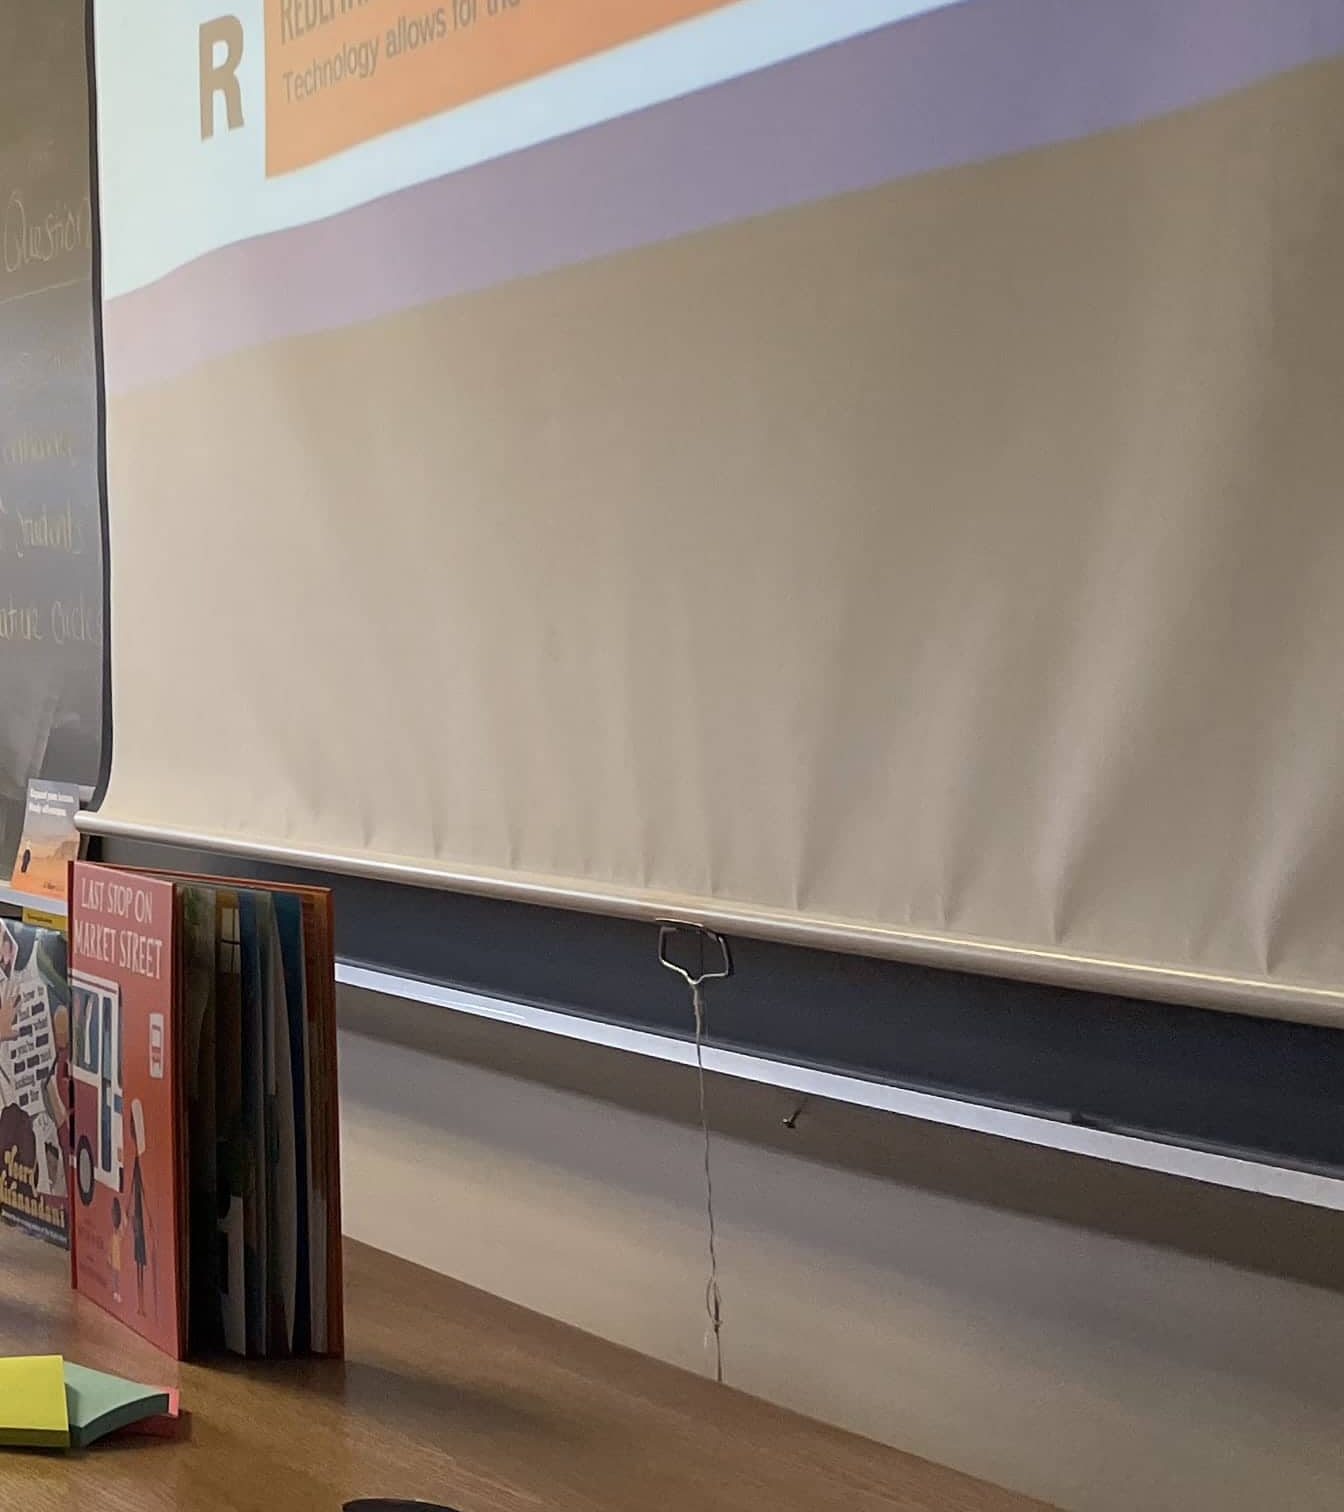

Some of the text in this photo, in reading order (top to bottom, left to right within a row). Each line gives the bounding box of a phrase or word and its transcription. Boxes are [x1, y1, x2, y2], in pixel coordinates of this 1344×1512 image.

[199, 14, 245, 142] R
[282, 34, 380, 105] Technology
[386, 2, 447, 60] allows
[81, 878, 153, 924] LAST STOP ON
[74, 919, 162, 980] MARKET STREET
